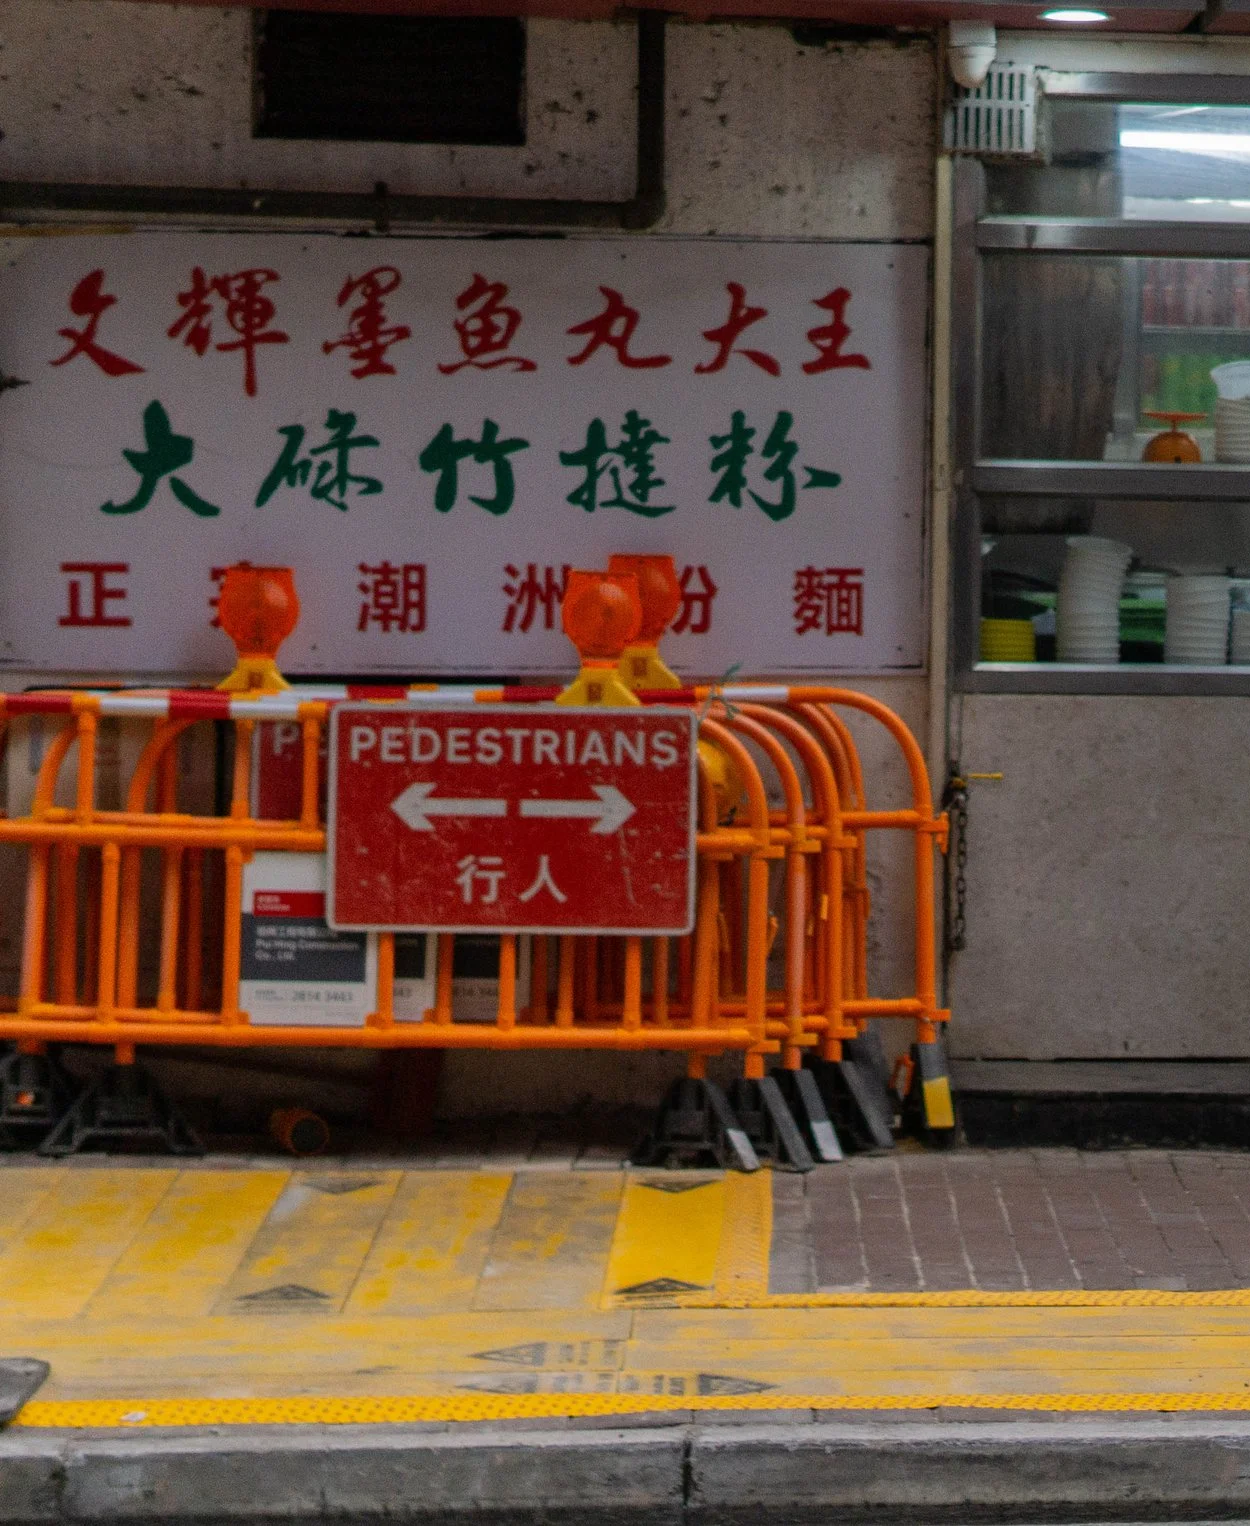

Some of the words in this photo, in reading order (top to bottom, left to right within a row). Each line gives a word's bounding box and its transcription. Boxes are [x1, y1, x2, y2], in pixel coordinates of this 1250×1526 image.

[49, 266, 872, 397] 文輝墨魚丸大王
[350, 726, 679, 768] PEDESTRIANS
[455, 854, 568, 903] 行人
